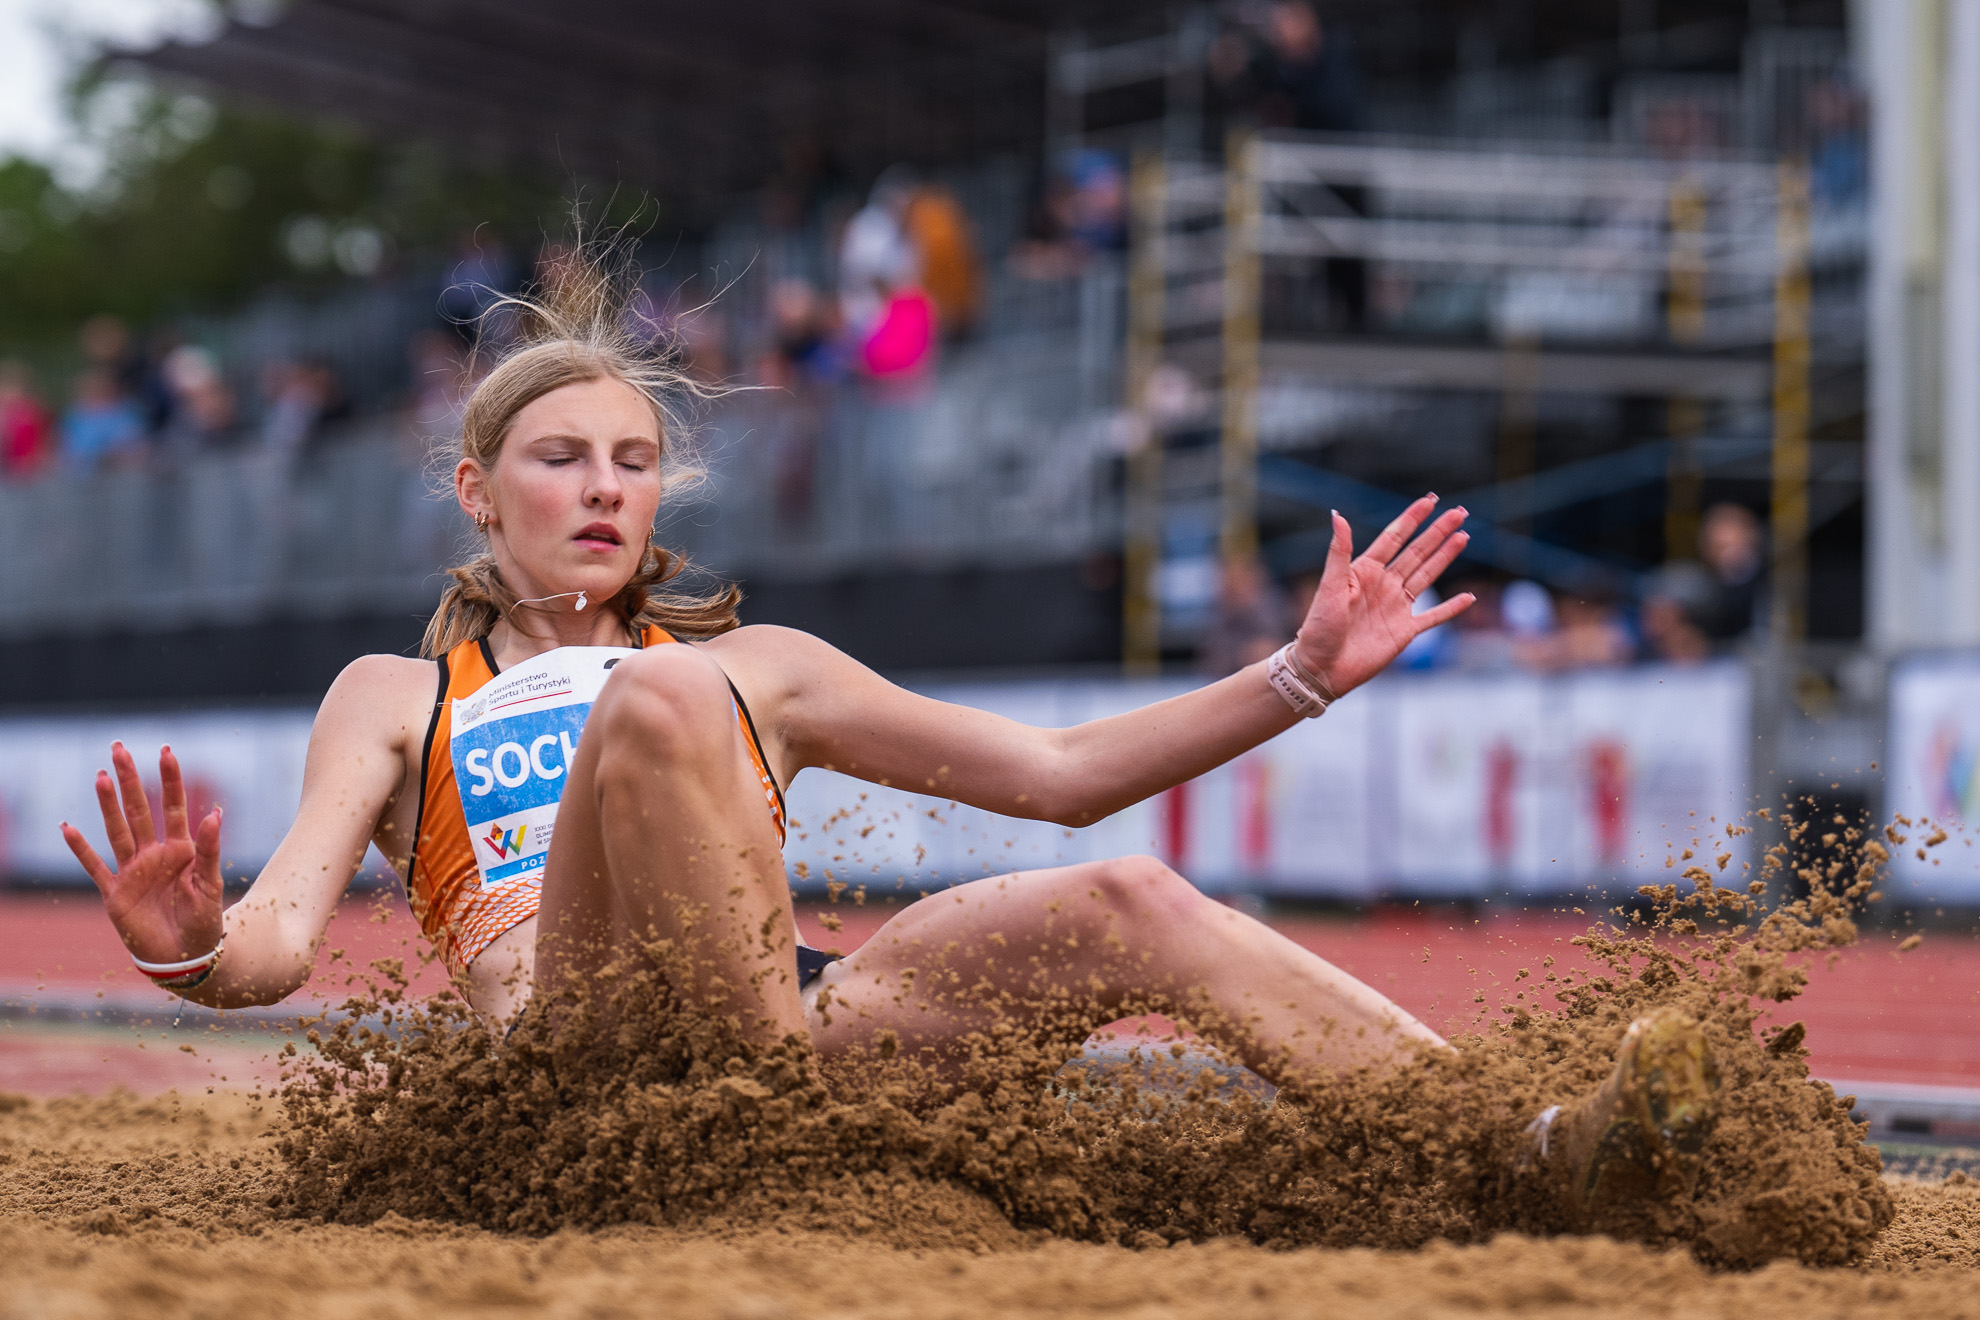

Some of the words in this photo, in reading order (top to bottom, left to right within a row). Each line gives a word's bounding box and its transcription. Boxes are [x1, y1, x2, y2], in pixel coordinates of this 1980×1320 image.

[488, 672, 548, 698] Ministerstwo
[488, 689, 519, 705] Sportu
[526, 676, 571, 692] Turystyki
